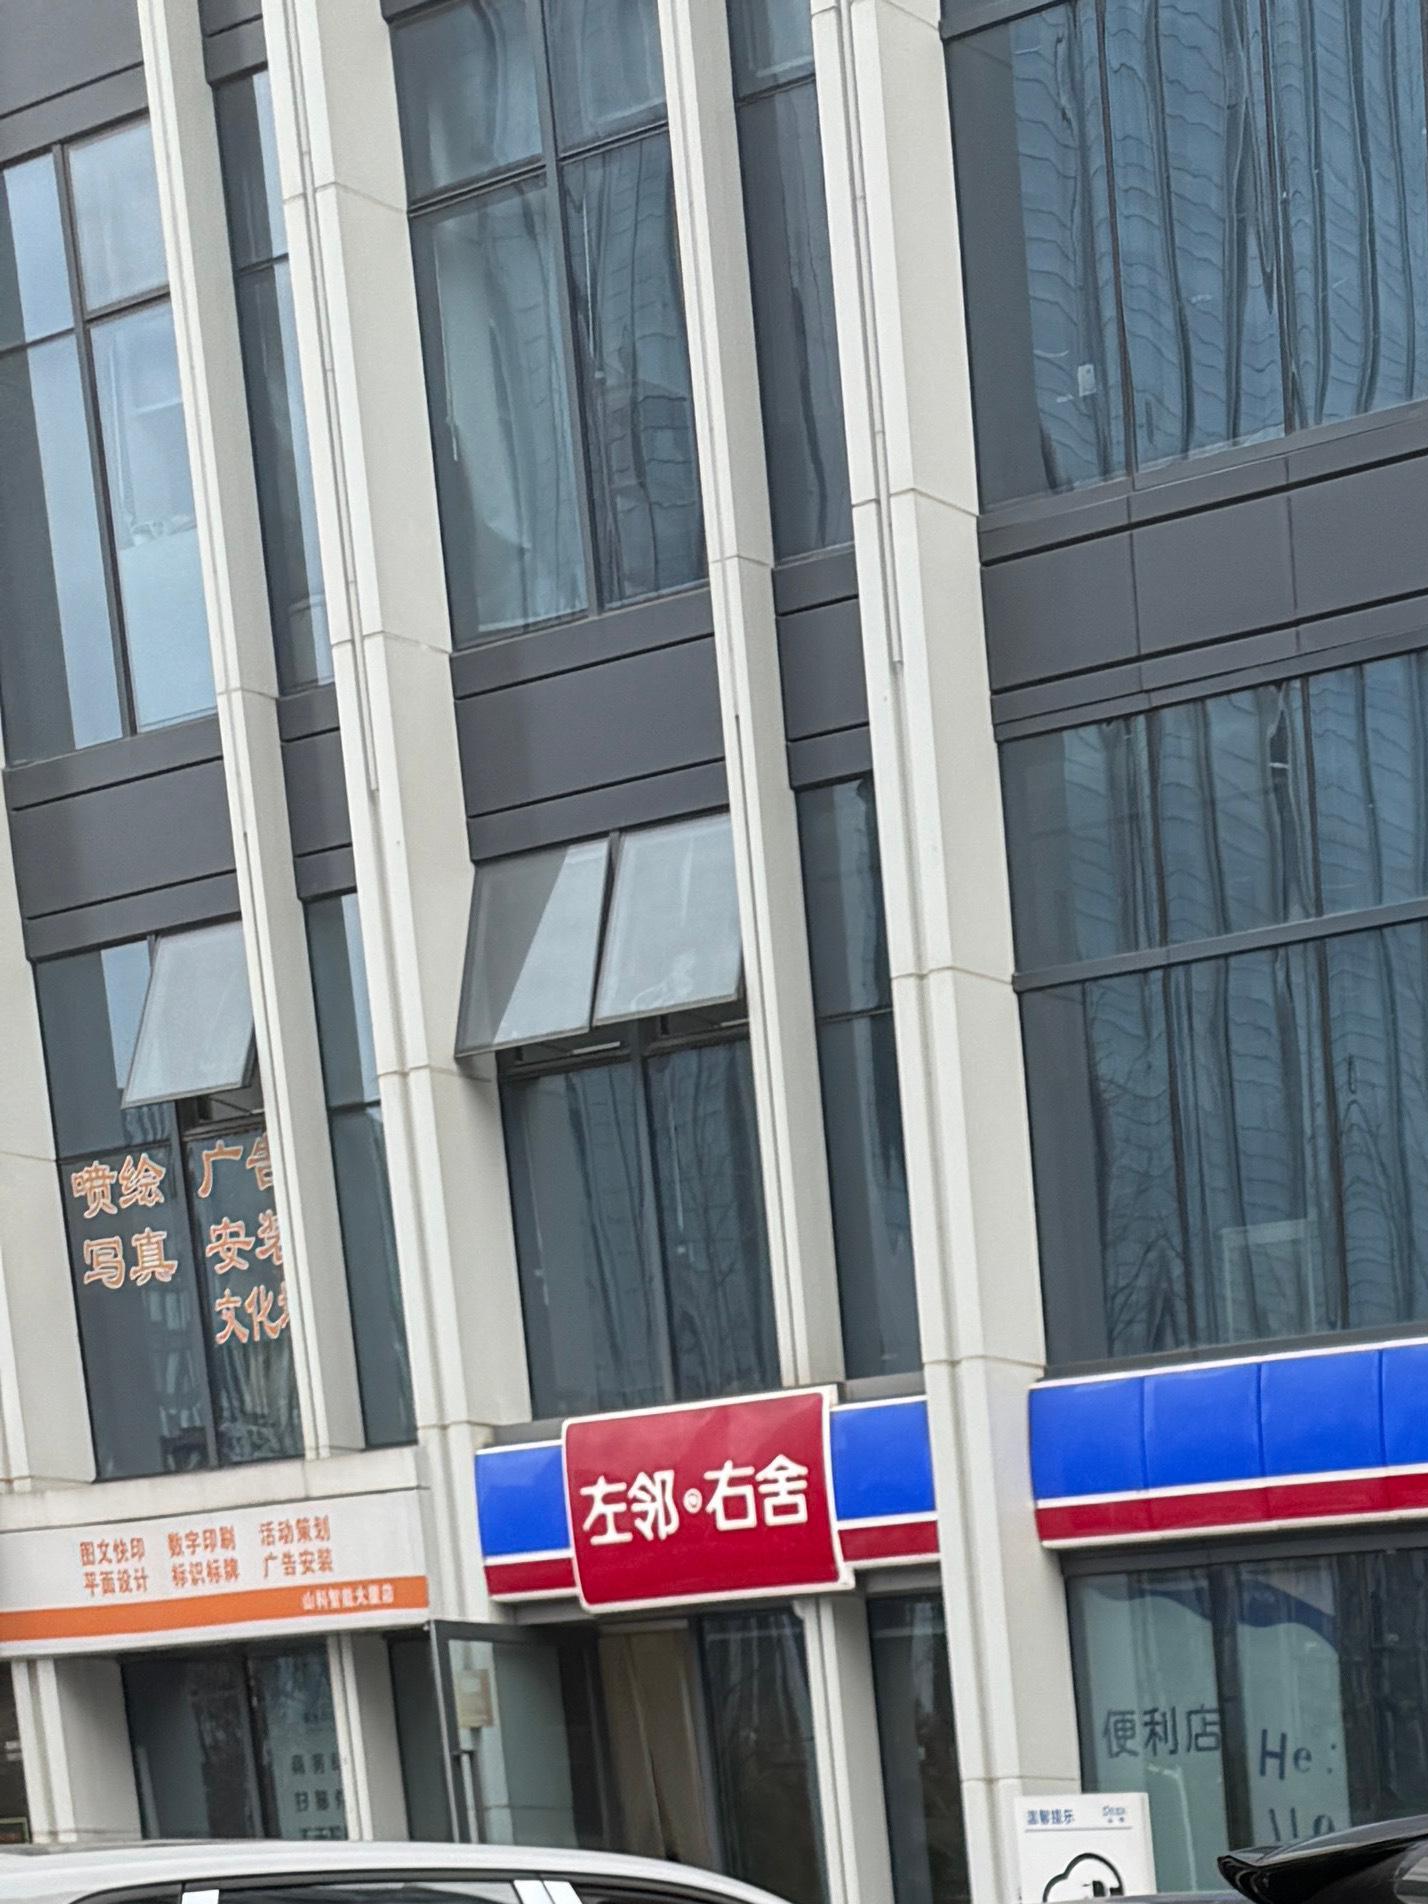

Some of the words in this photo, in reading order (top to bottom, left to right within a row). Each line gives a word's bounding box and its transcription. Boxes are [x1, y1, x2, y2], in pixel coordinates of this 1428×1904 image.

[71, 1153, 166, 1219] 喷绘
[198, 1132, 275, 1198] 广告
[83, 1227, 178, 1289] 写真
[205, 1209, 284, 1274] 安装
[79, 1537, 146, 1567] 图文快印
[167, 1525, 236, 1558] 数字印刷
[258, 1515, 331, 1547] 活动策划
[83, 1565, 148, 1597] 平面设计
[171, 1557, 239, 1588] 标识标牌
[262, 1548, 334, 1579] 广告安装
[1103, 1703, 1222, 1759] 便利店
